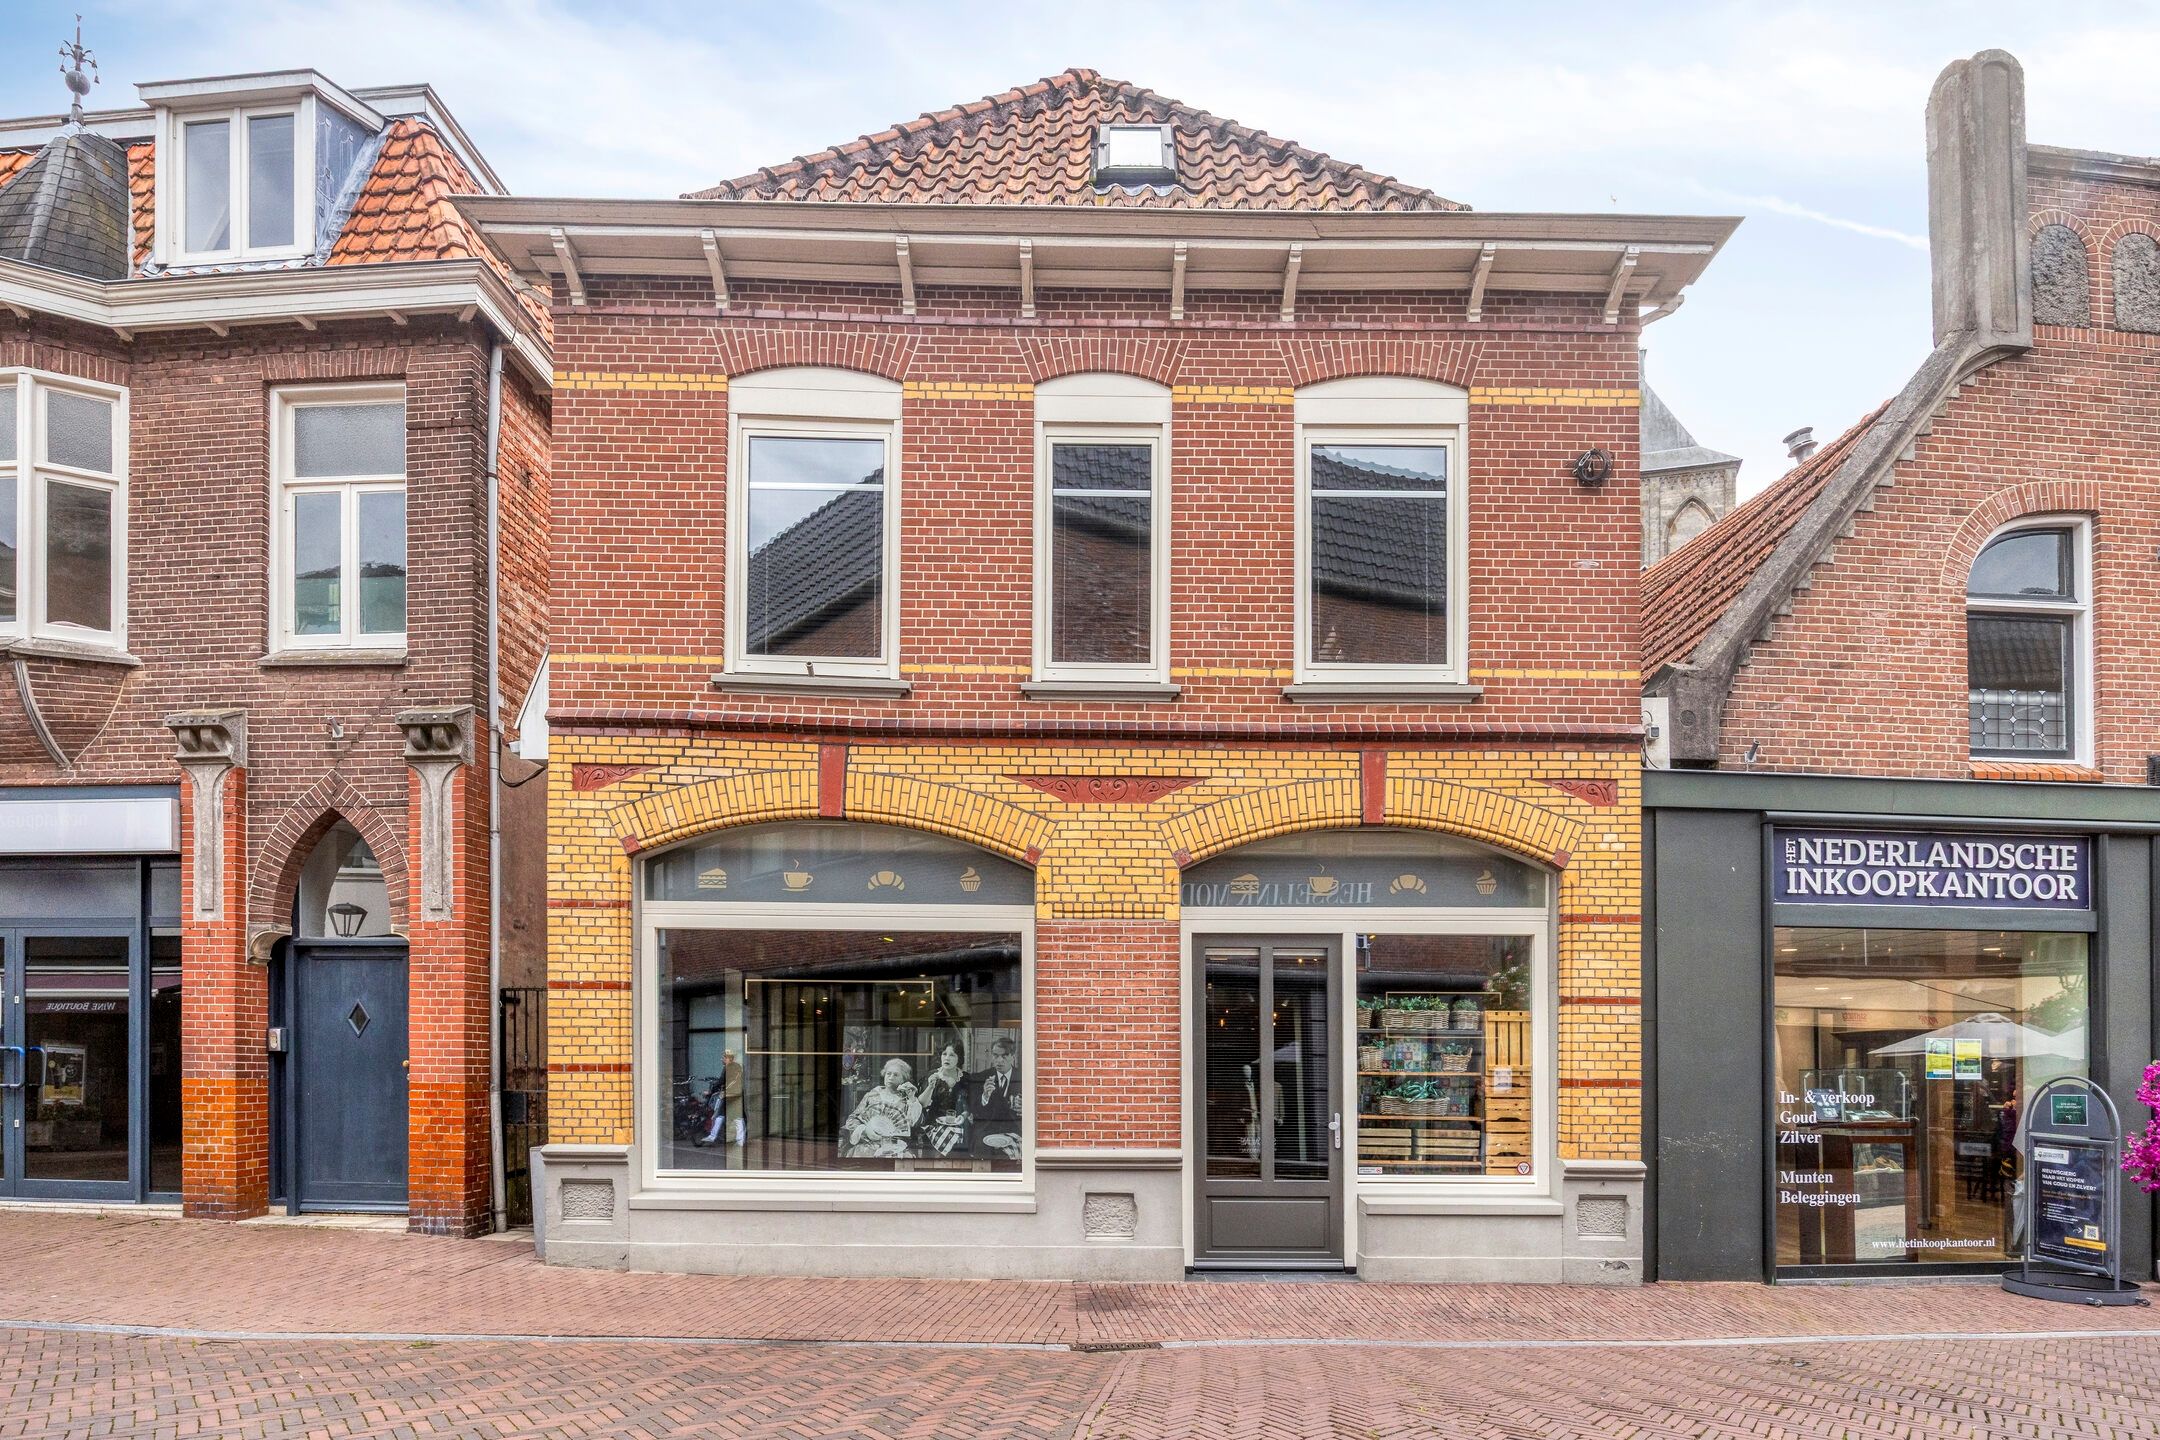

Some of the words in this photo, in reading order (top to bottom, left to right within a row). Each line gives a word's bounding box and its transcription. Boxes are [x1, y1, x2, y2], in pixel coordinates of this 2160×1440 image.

[1786, 838, 1796, 864] HET
[1798, 838, 2078, 871] NEDERLANDSCHE
[1787, 867, 2078, 900] INKOOPKANTOOR
[1780, 1090, 1800, 1104] In-
[1804, 1090, 1817, 1104] &
[1821, 1091, 1875, 1107] verkoop
[1780, 1111, 1817, 1124] Goud
[1780, 1131, 1821, 1144] Zilver
[1780, 1171, 1833, 1184] Munten
[1780, 1190, 1861, 1206] Beleggingen
[1871, 1237, 1996, 1250] www.hetinkoopkantoor.nl
